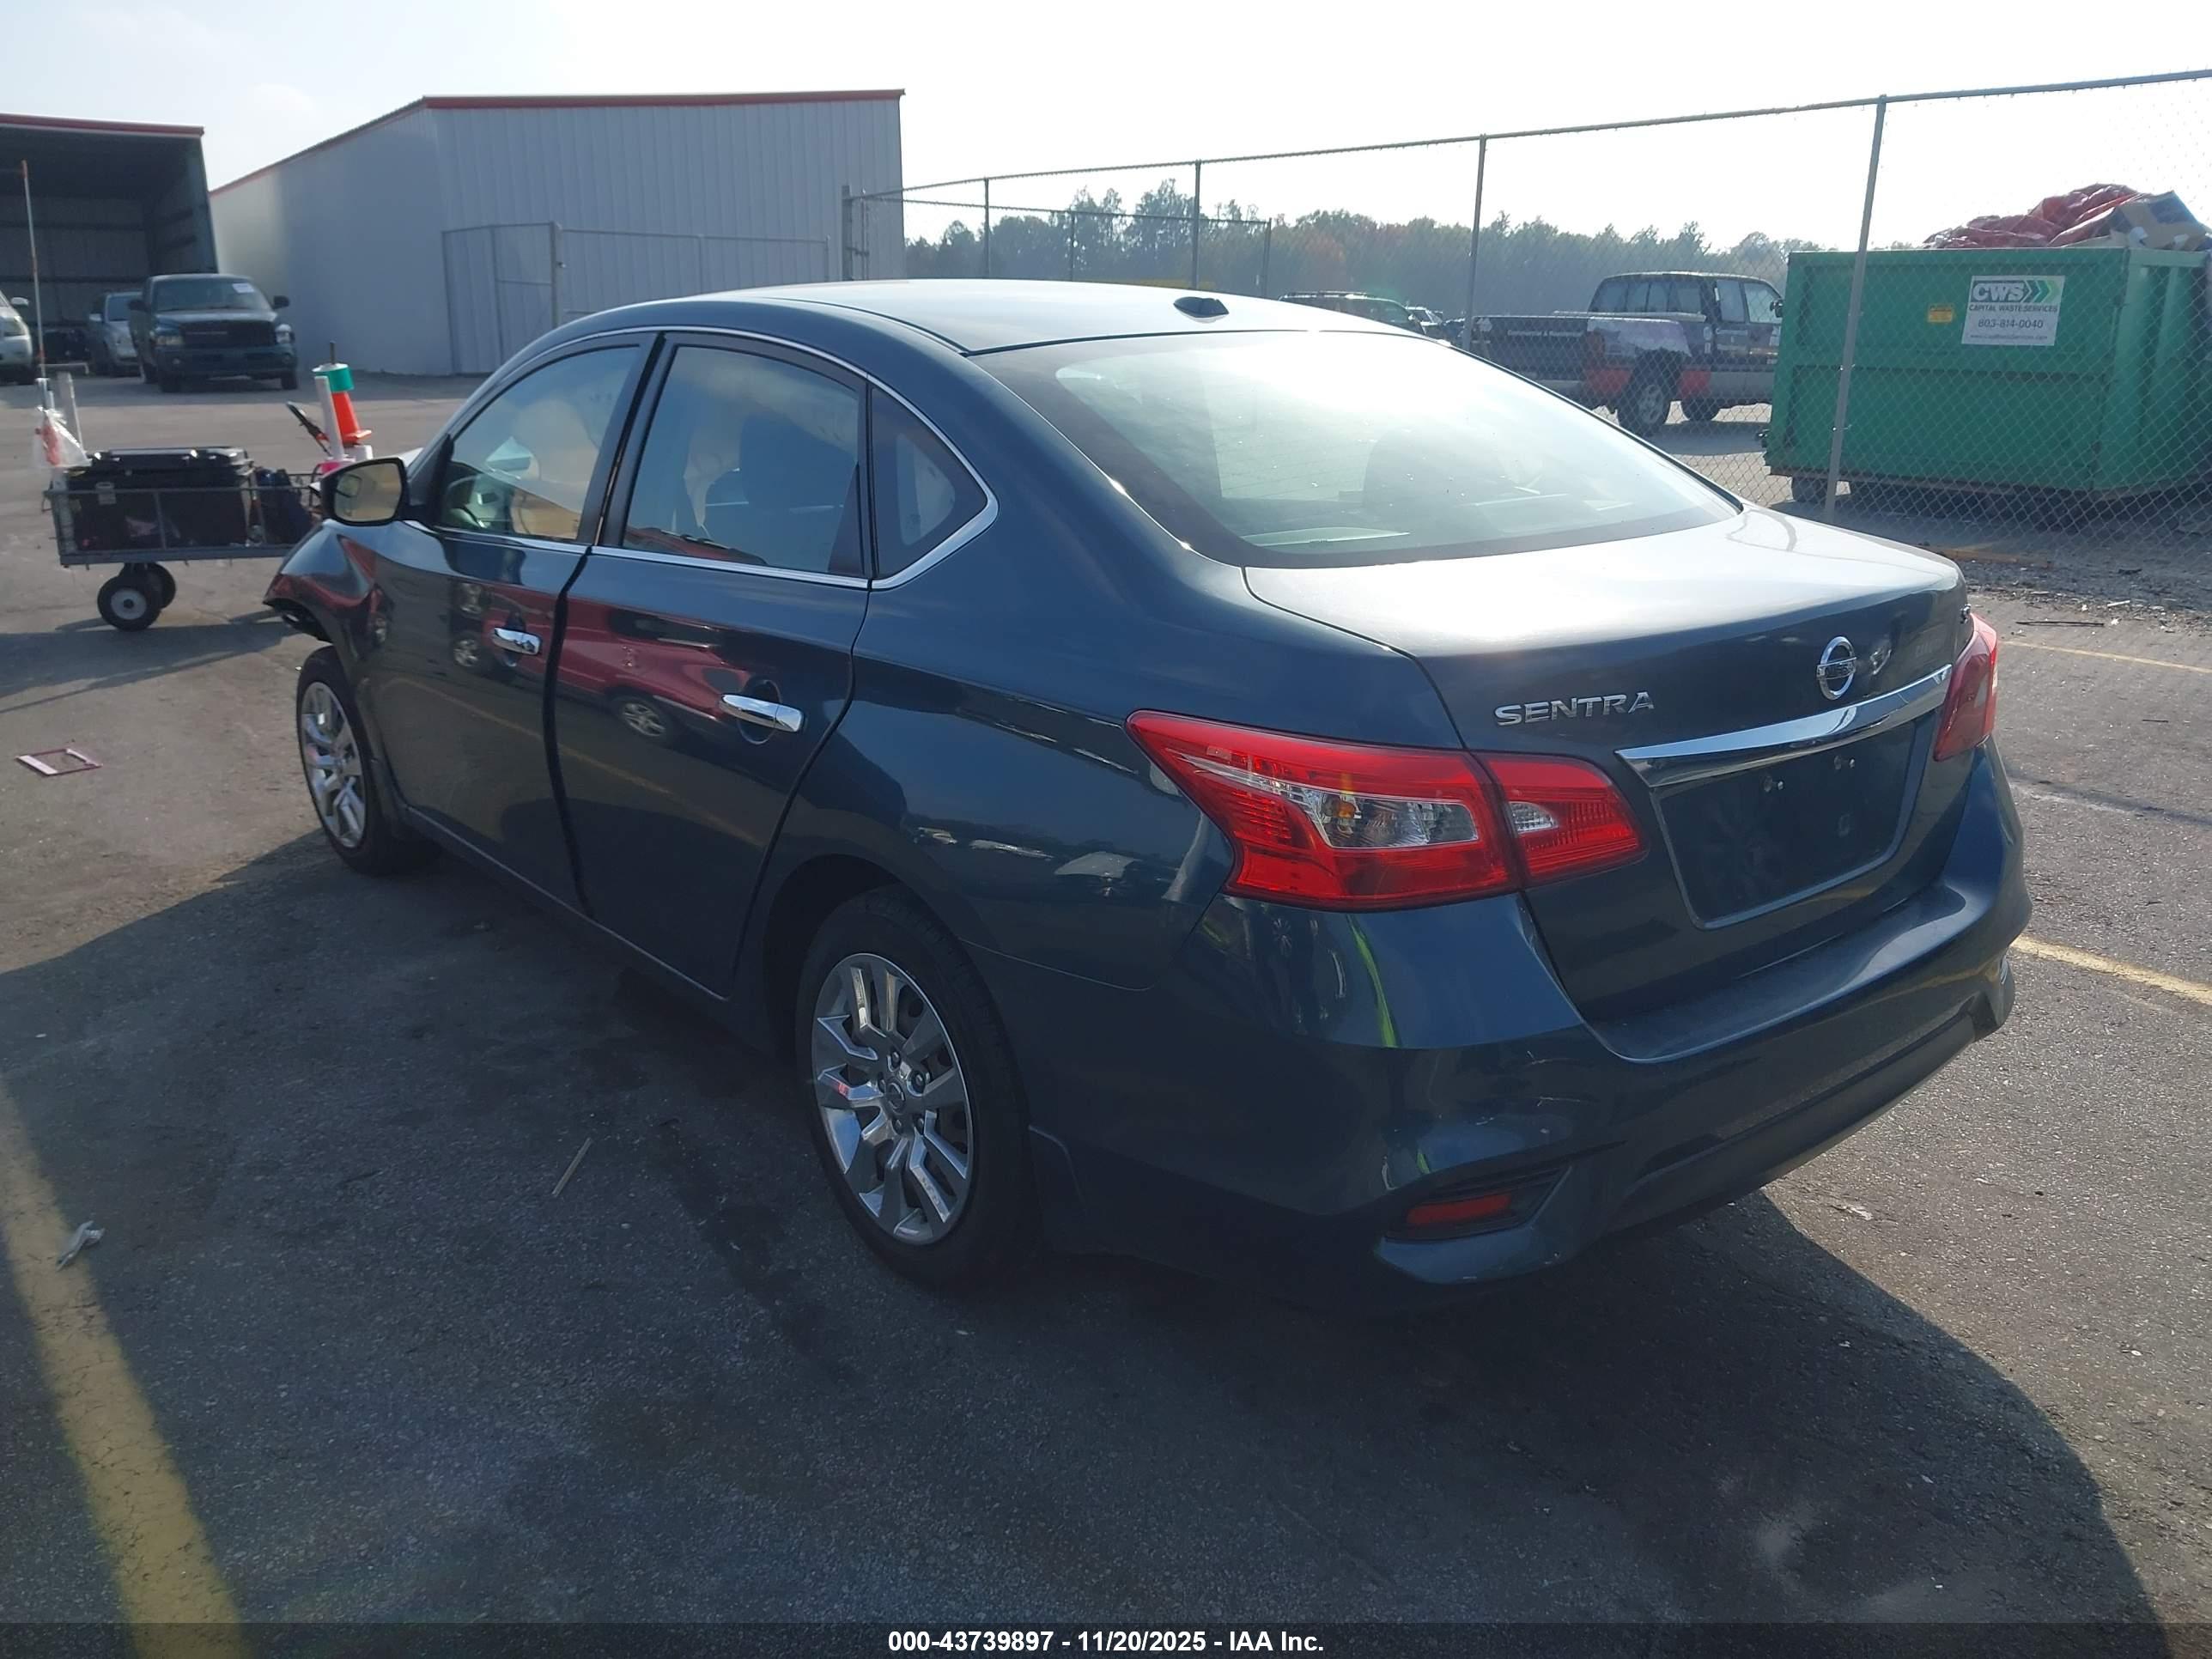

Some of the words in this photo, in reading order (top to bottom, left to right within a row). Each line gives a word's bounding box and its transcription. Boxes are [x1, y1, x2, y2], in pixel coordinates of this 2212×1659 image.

[1972, 283, 2025, 301] CWS
[1978, 319, 2044, 329] 803-814-0040
[1494, 691, 1655, 726] SENTRA
